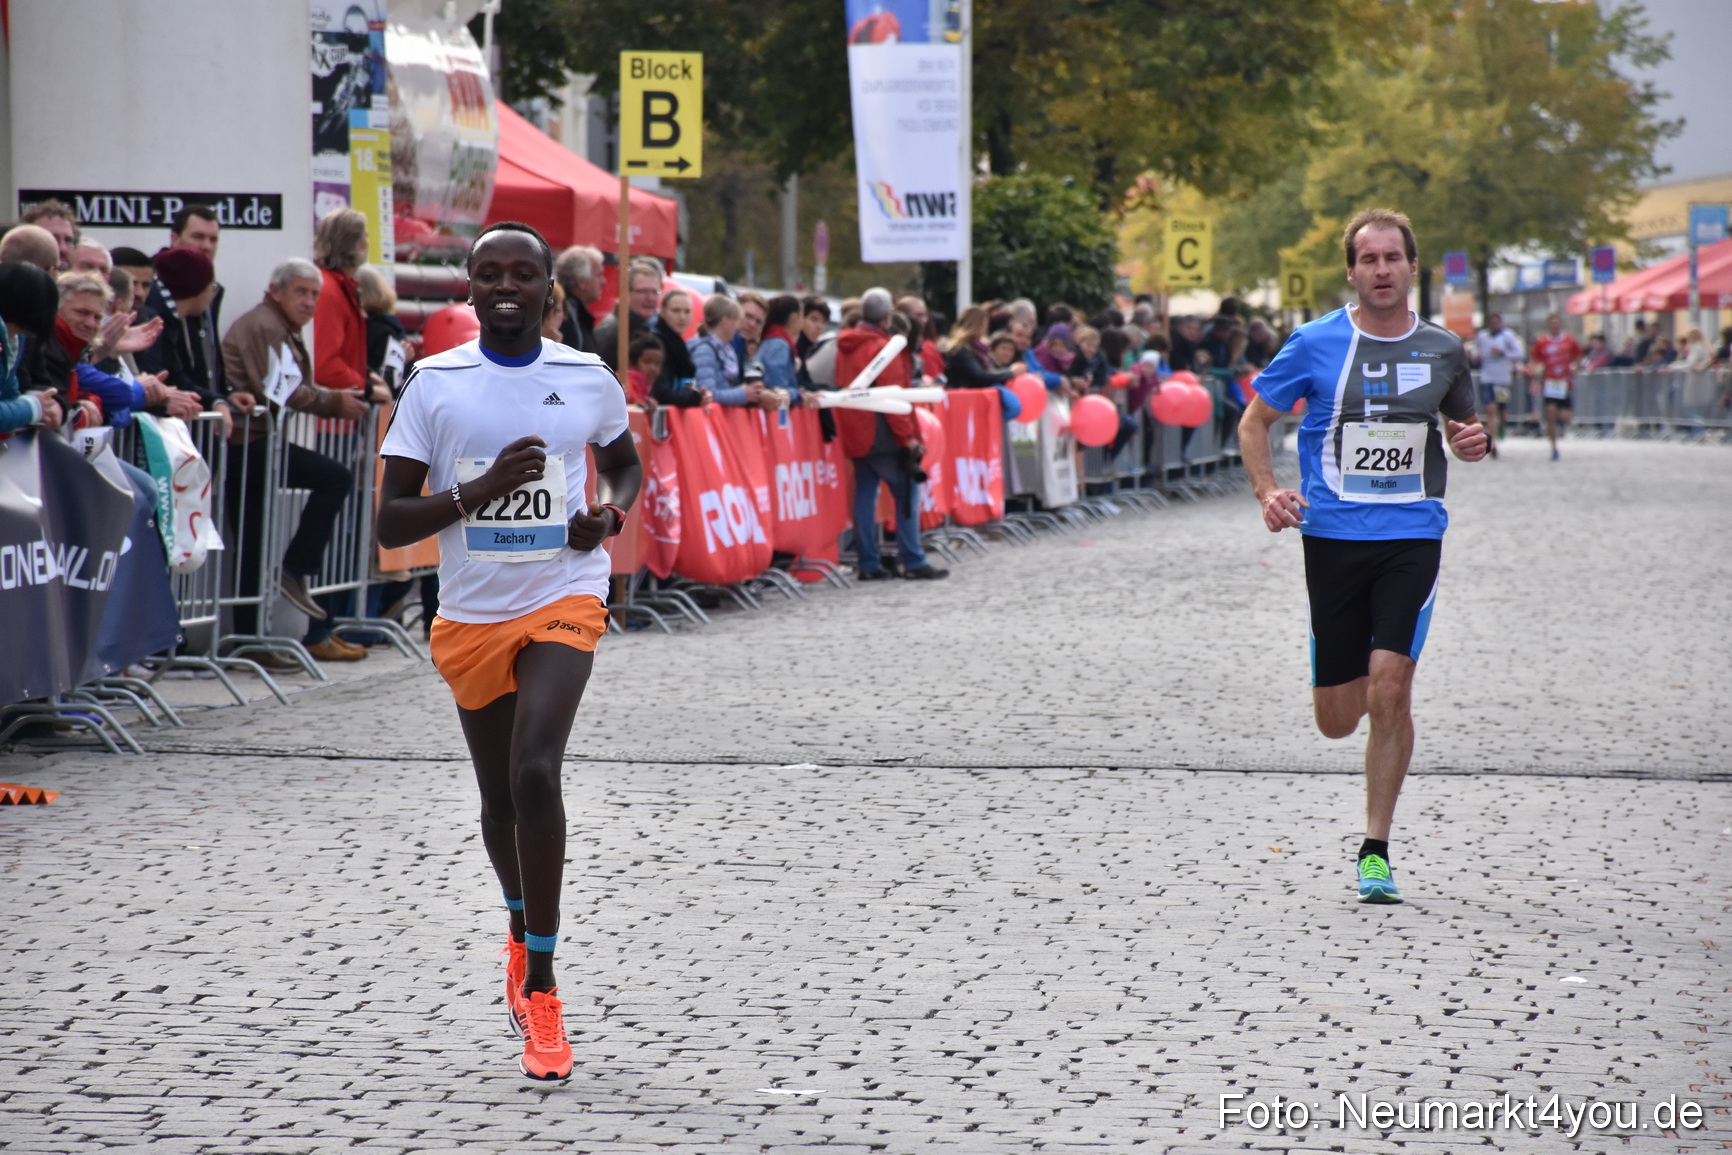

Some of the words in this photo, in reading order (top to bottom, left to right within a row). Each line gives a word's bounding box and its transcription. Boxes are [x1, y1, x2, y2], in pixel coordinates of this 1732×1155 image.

[631, 58, 692, 80] Block
[642, 90, 681, 149] B
[1177, 237, 1199, 270] C
[1289, 273, 1306, 298] D
[1355, 447, 1413, 471] 2284
[1370, 479, 1397, 489] Martin
[476, 488, 551, 521] 2220
[494, 533, 536, 545] Zachary
[560, 622, 582, 635] asics
